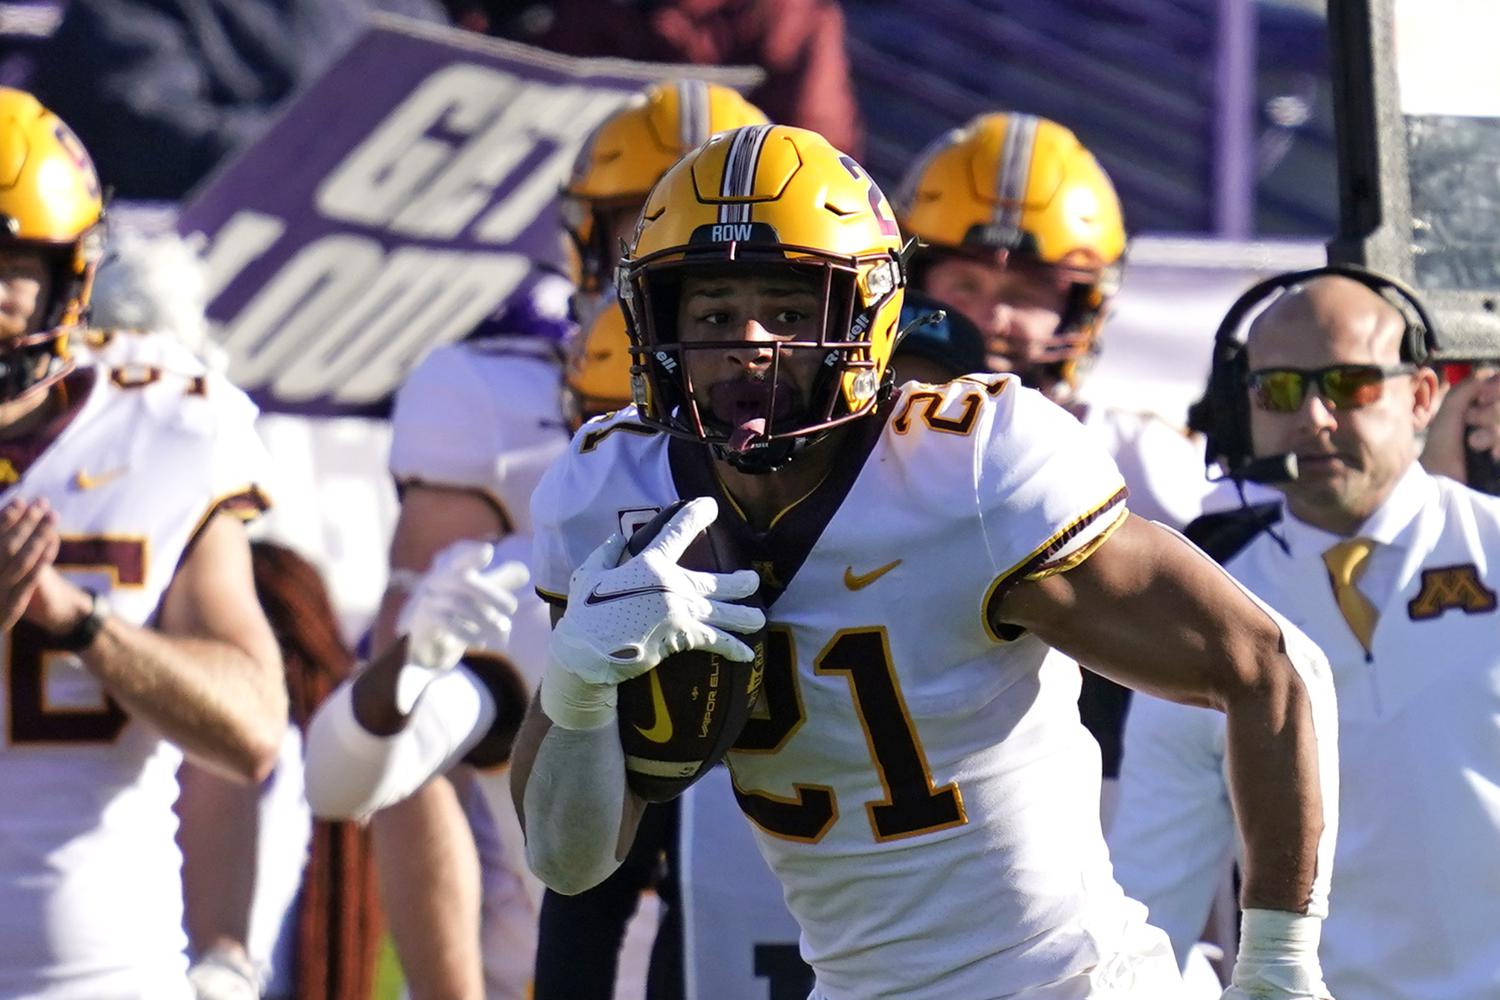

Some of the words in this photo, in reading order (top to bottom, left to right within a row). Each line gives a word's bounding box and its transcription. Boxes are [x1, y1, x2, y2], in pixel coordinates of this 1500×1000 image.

[315, 62, 634, 243] GET
[712, 224, 752, 243] ROW
[824, 313, 869, 367] Riell
[698, 690, 718, 738] VAPOR
[710, 654, 720, 688] ELIT
[726, 622, 969, 844] 21
